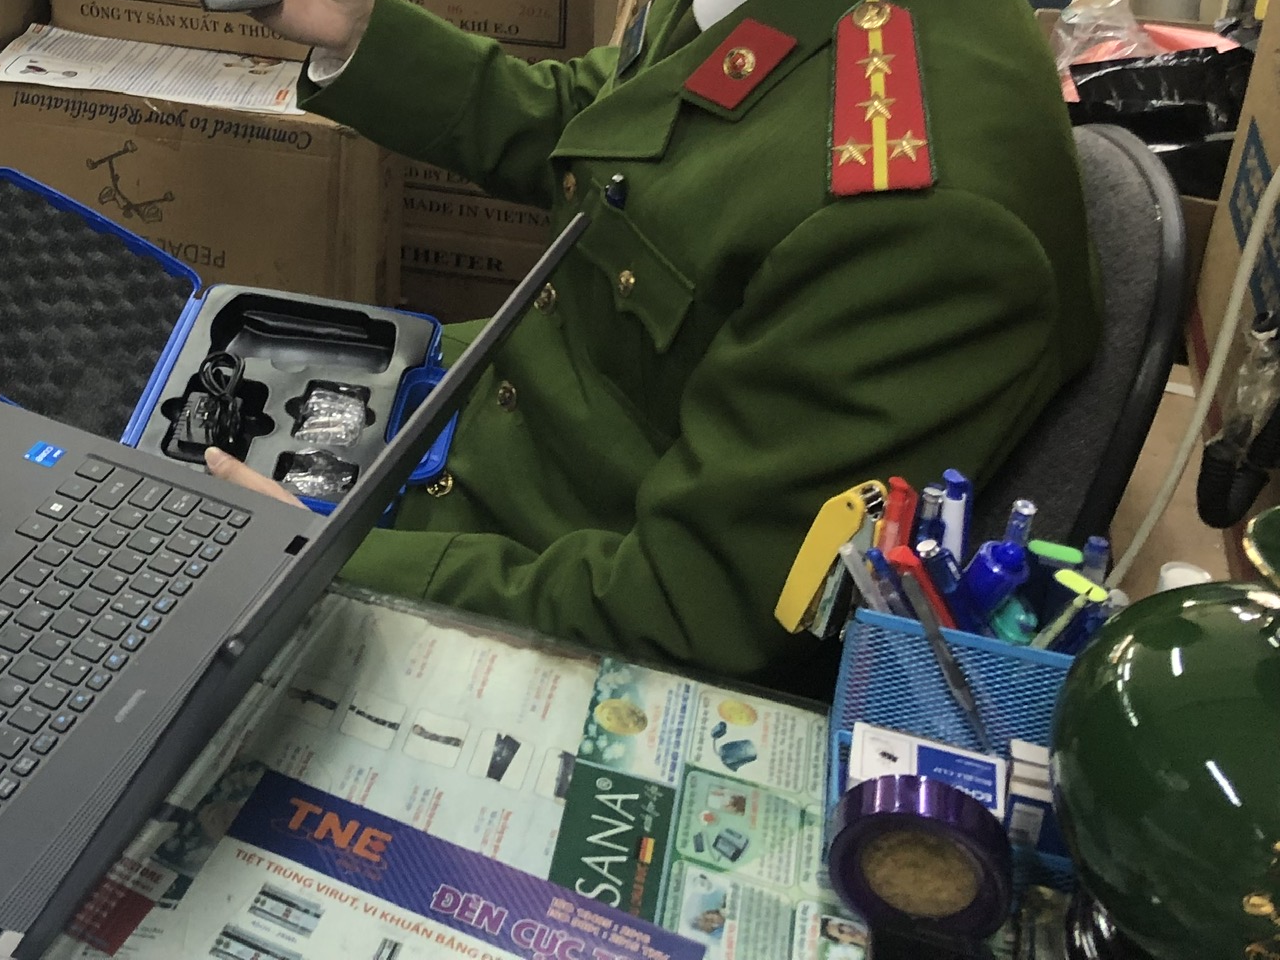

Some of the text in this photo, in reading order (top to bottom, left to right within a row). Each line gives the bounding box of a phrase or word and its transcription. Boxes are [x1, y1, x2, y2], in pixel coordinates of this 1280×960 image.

[80, 1, 121, 21] CÔNG
[124, 8, 142, 24] TY
[180, 14, 220, 33] XUẤT
[223, 21, 235, 35] &
[11, 89, 313, 151] Committed to your Rehabilitation!
[403, 197, 453, 214] MADE
[459, 204, 479, 218] IN
[289, 796, 393, 864] TNE
[575, 792, 640, 908] SANA
[363, 903, 378, 917] VI
